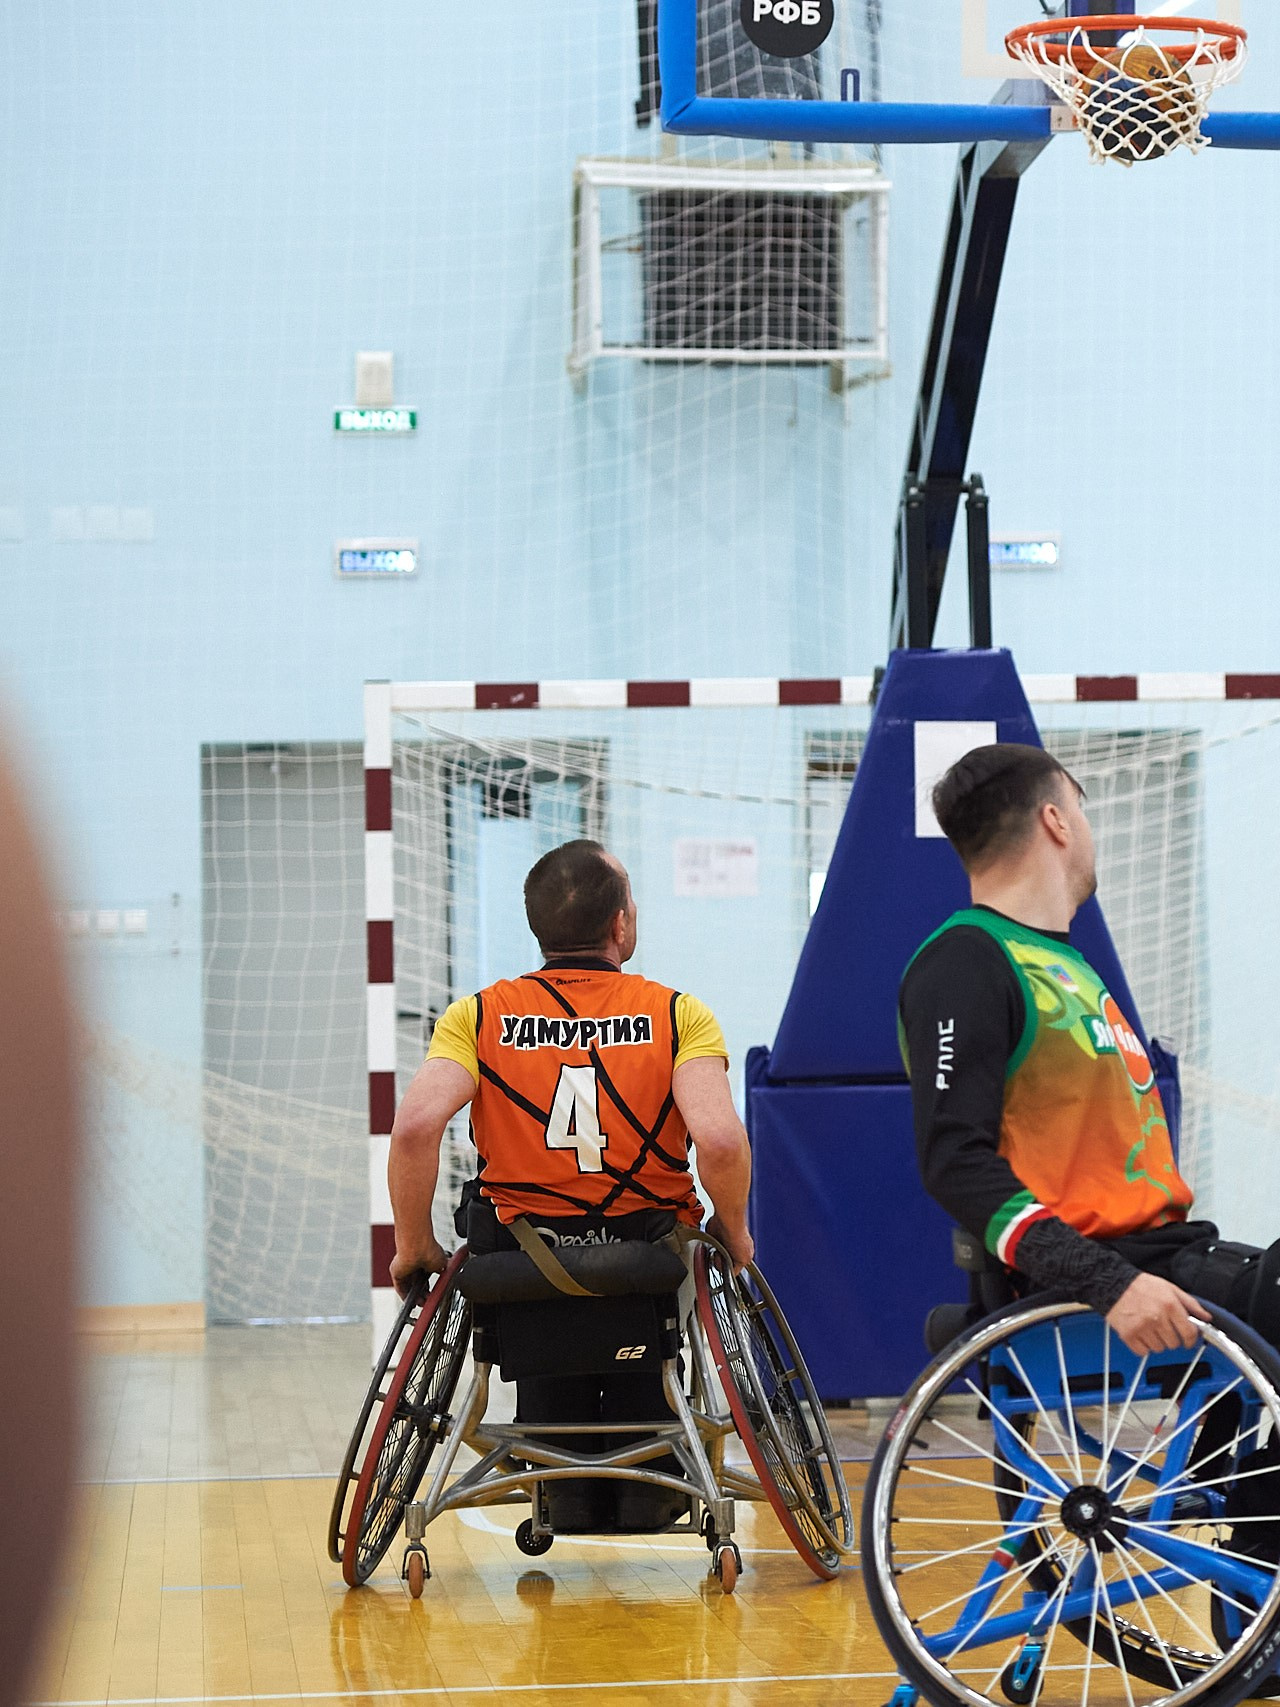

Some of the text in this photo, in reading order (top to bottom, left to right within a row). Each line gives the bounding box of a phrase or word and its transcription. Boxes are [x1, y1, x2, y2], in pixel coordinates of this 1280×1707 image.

[752, 0, 822, 26] РФБ
[500, 1014, 653, 1050] УДМУРТИЯ
[544, 1063, 608, 1173] 4
[614, 1345, 647, 1361] G2
